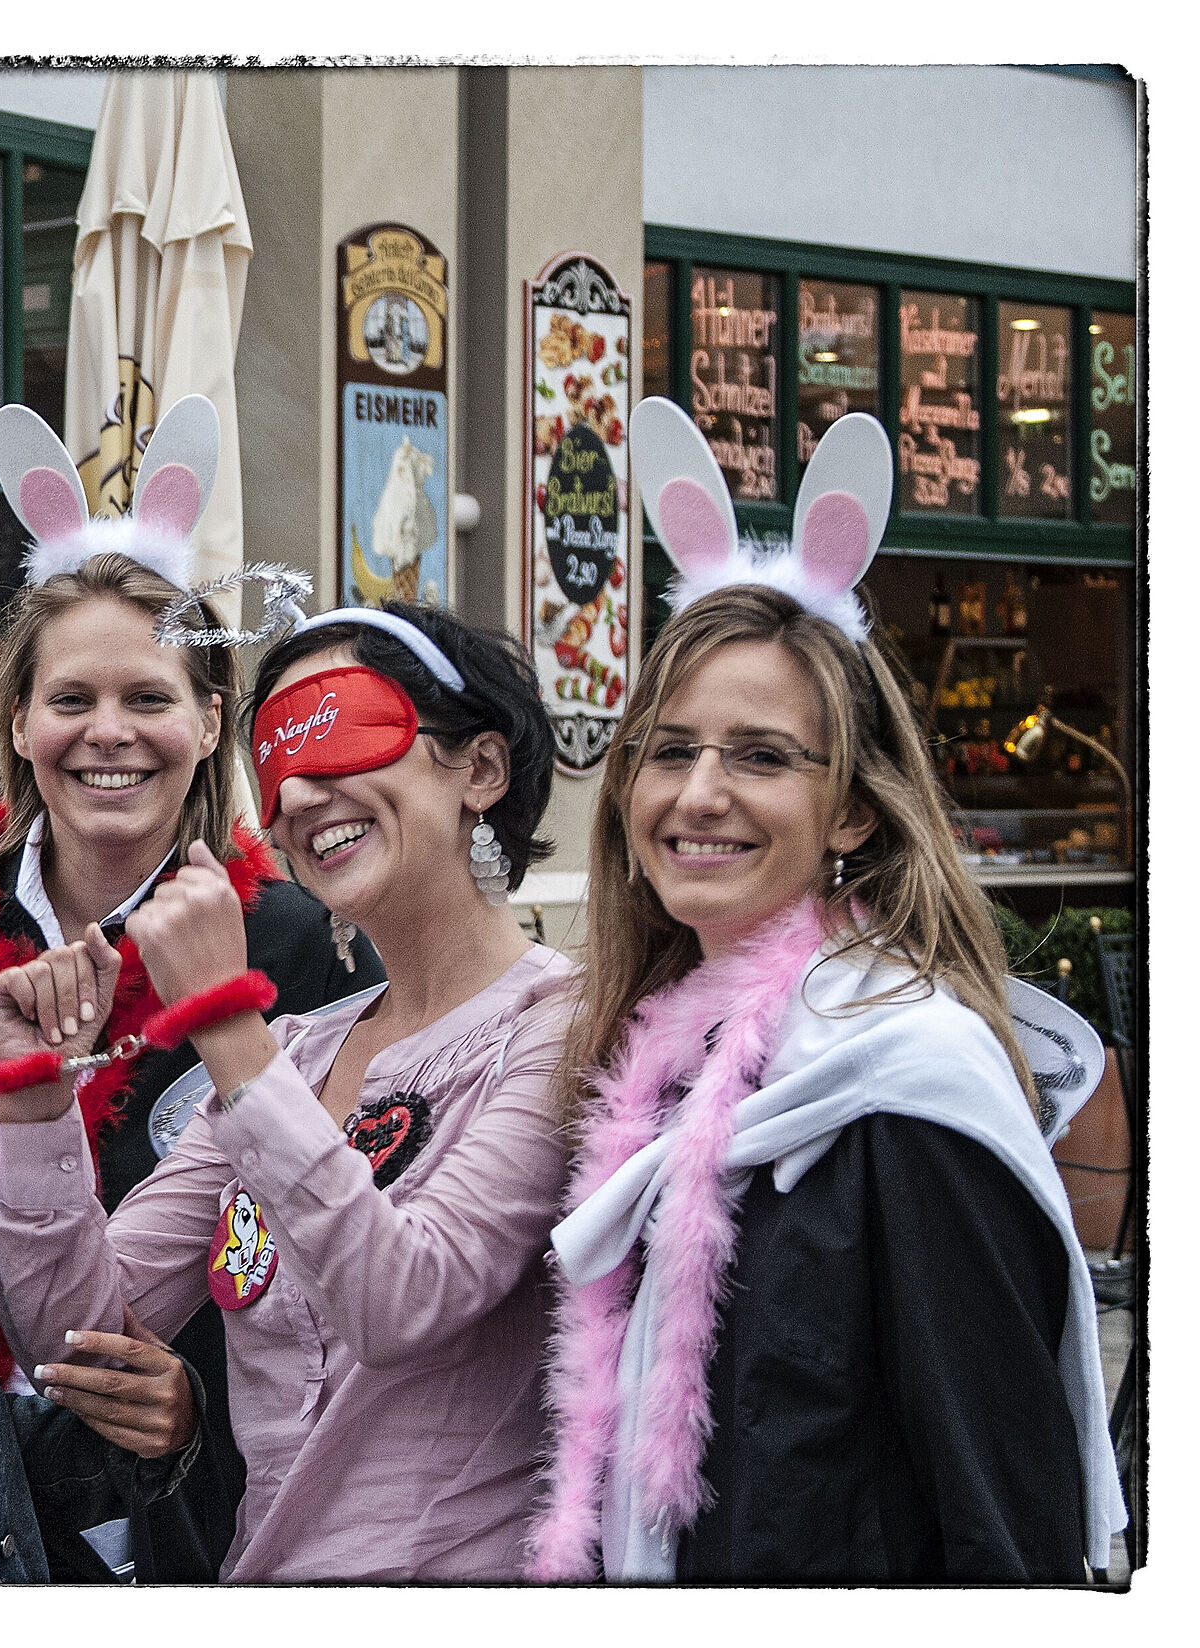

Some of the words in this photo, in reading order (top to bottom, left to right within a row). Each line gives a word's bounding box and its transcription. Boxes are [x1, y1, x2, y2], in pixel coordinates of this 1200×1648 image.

[354, 391, 439, 430] EISMEHR
[691, 350, 776, 417] Schnitzel
[547, 475, 616, 518] Bratwurst
[258, 740, 273, 765] Be
[274, 692, 340, 755] Naughty
